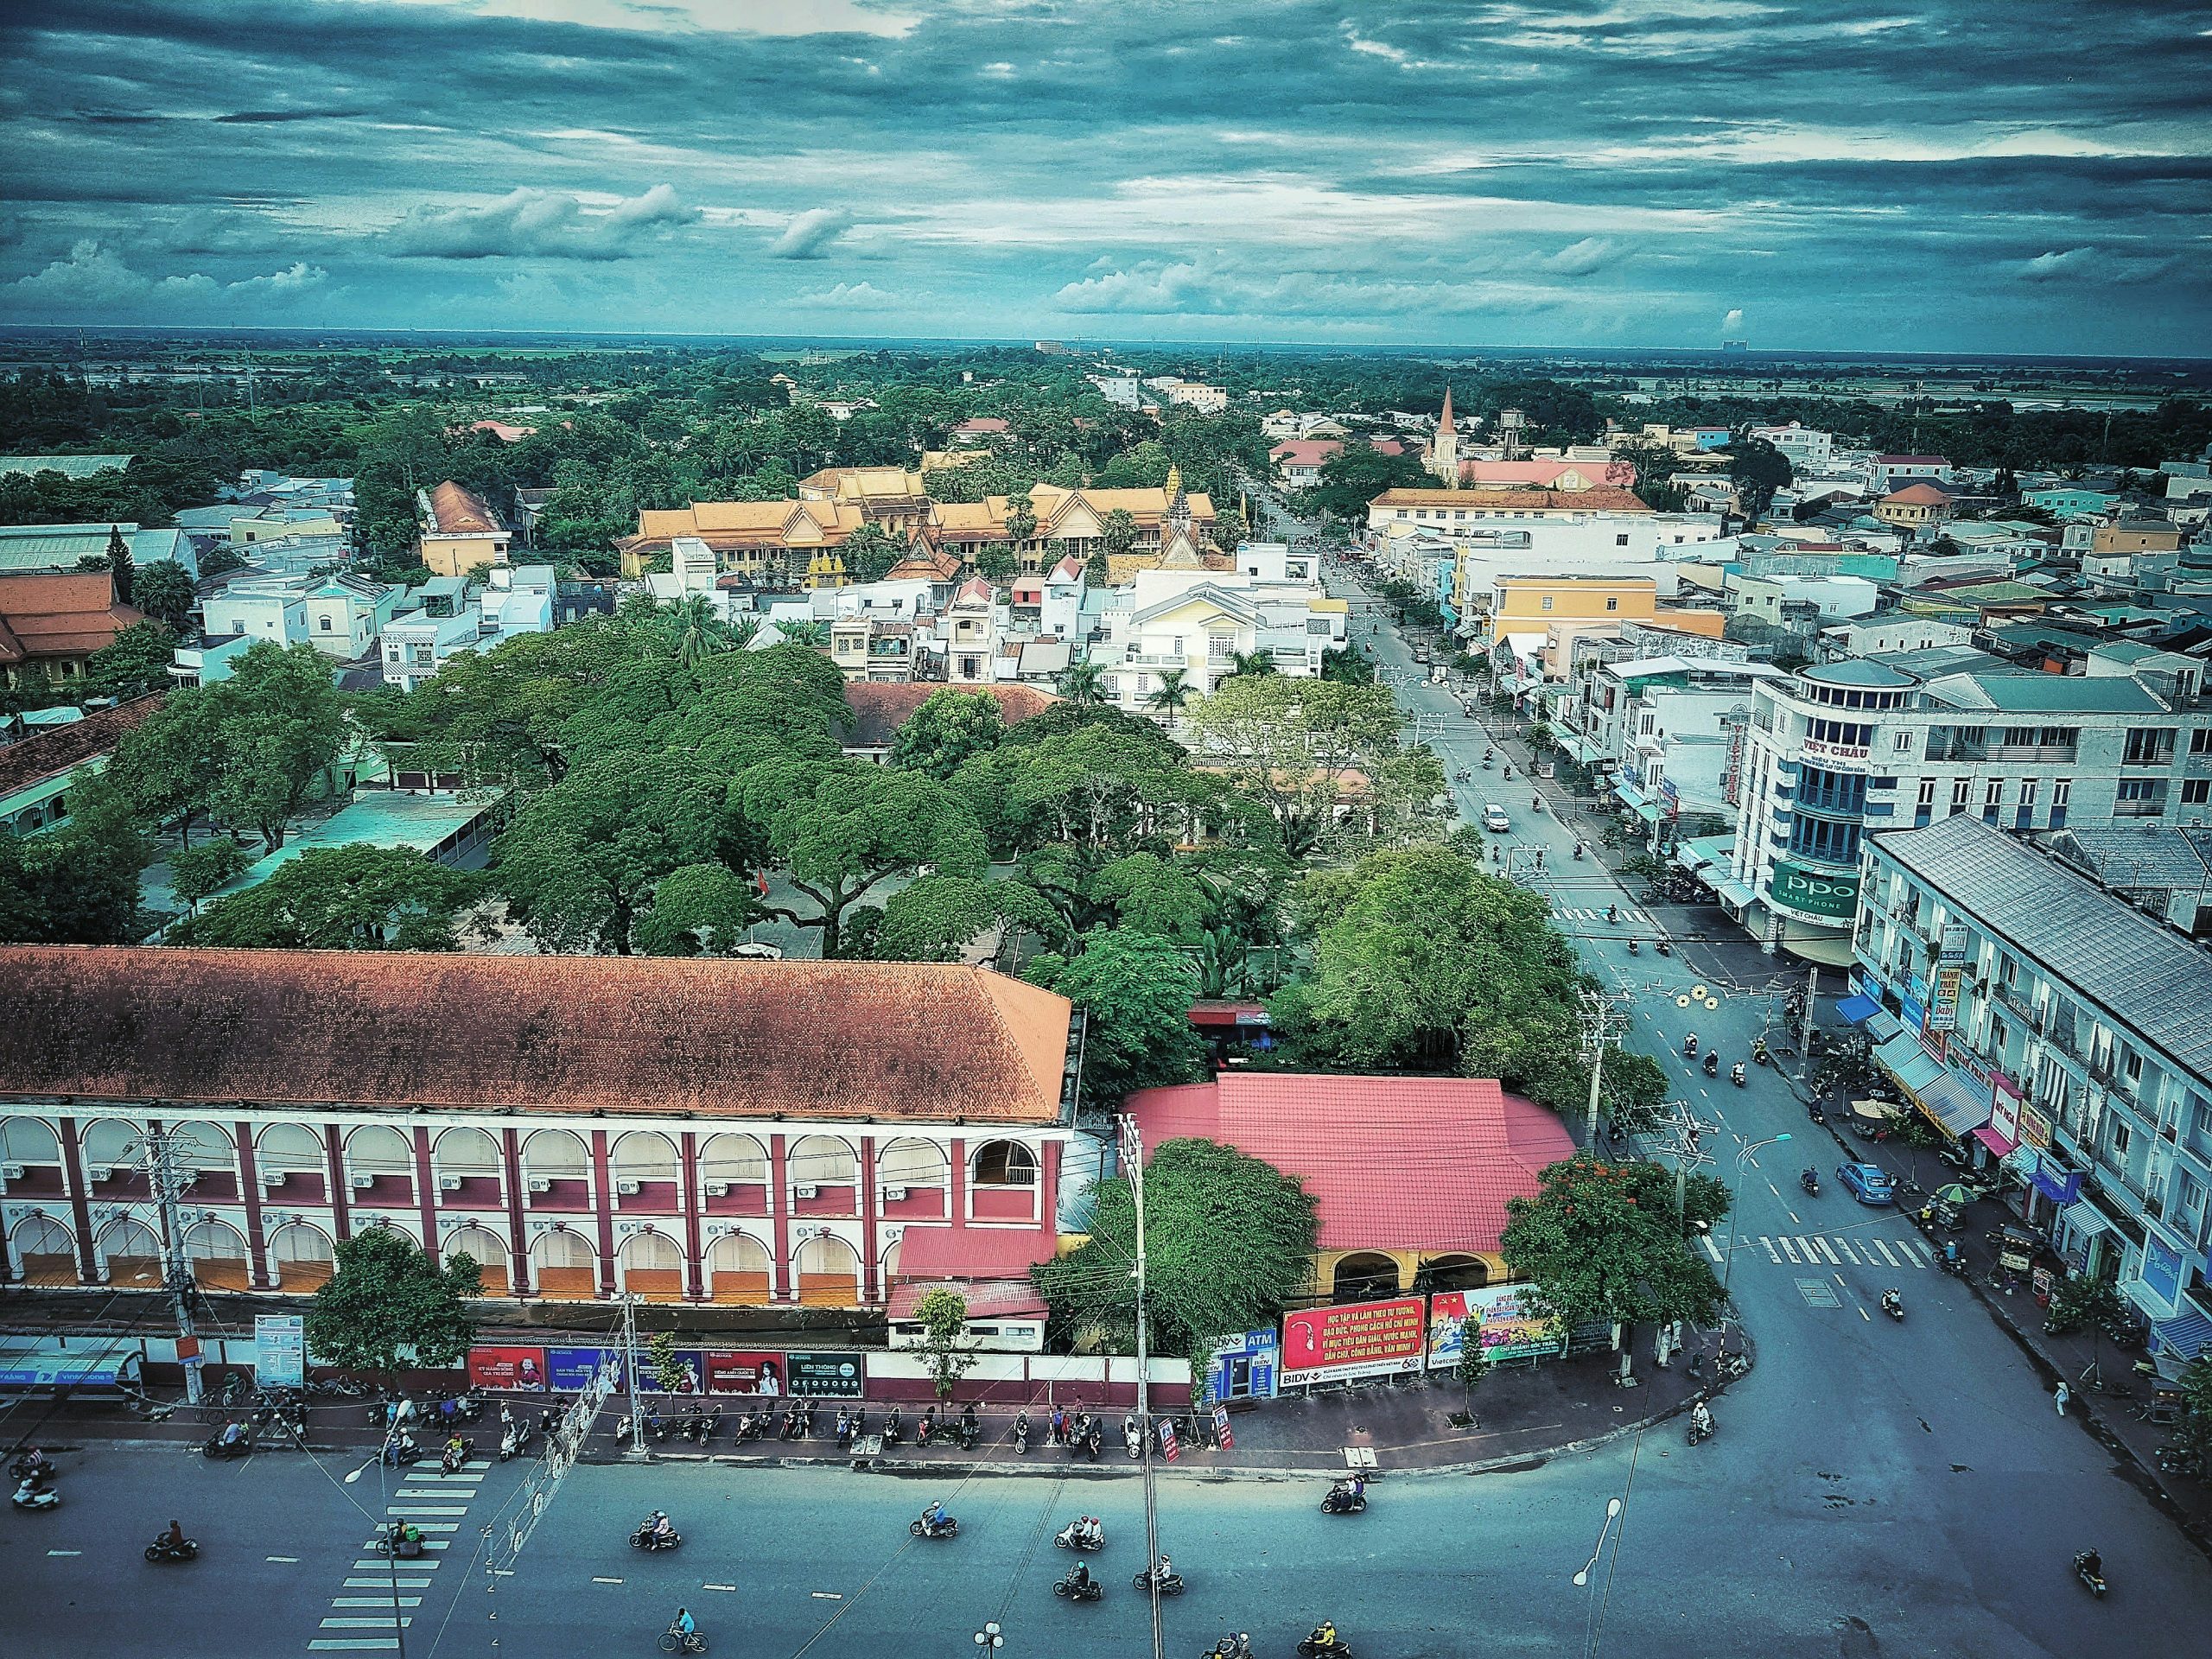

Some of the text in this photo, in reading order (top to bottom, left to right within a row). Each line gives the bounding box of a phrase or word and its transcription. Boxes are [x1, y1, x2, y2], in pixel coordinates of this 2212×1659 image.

[1804, 739, 1868, 758] VIỆT CHÂU
[1936, 1004, 1955, 1016] Baby
[1328, 1315, 1338, 1325] HỌC
[1340, 1313, 1351, 1324] TẬP
[1351, 1311, 1358, 1320] VÀ
[1360, 1310, 1371, 1319] LÀM
[1323, 1328, 1334, 1338] ĐẠO
[1350, 1324, 1368, 1333] PHONG
[1370, 1320, 1383, 1331] CÁCH
[1385, 1319, 1392, 1329] HỒ
[1394, 1318, 1402, 1327] CHÍ
[1404, 1318, 1418, 1326] MINH
[1248, 1334, 1272, 1346] ATM
[1329, 1339, 1342, 1349] MỤC
[1351, 1348, 1365, 1357] CÔNG
[1396, 1343, 1410, 1351] MINH
[1284, 1372, 1309, 1383] BIDV
